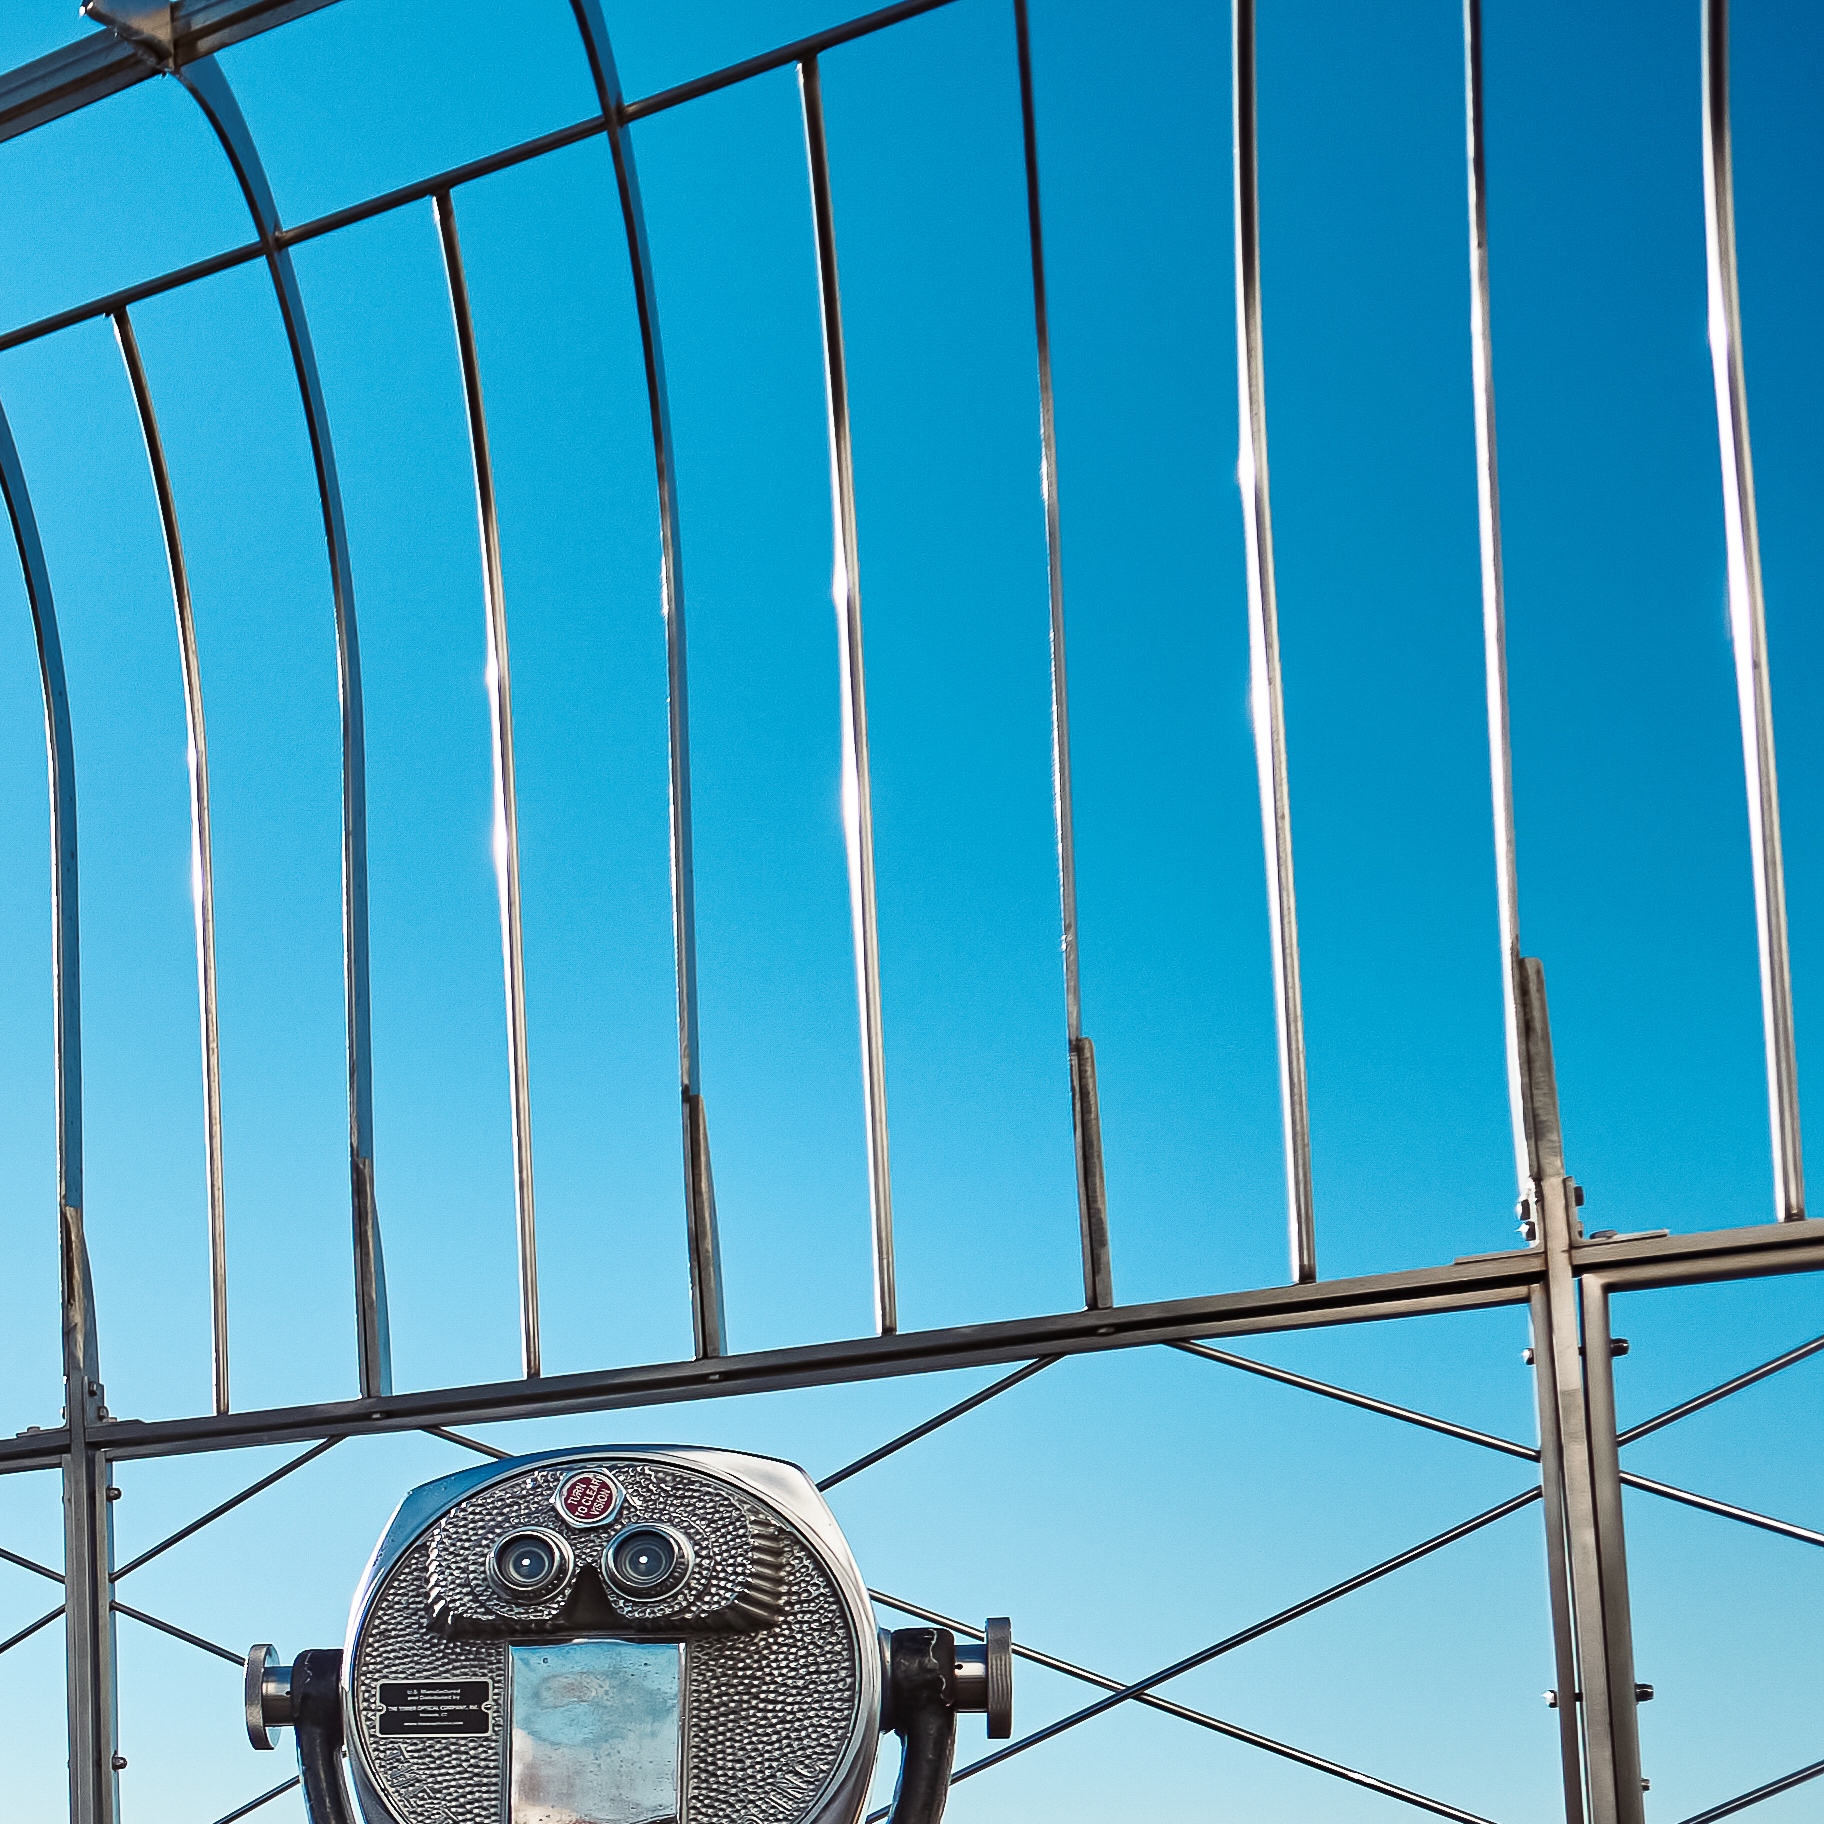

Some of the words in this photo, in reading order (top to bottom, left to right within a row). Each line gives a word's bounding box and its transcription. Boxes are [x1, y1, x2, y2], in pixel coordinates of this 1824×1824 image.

[567, 1483, 587, 1505] TURN
[574, 1505, 588, 1517] TO
[581, 1475, 603, 1506] CLEAR
[589, 1488, 611, 1515] VISION
